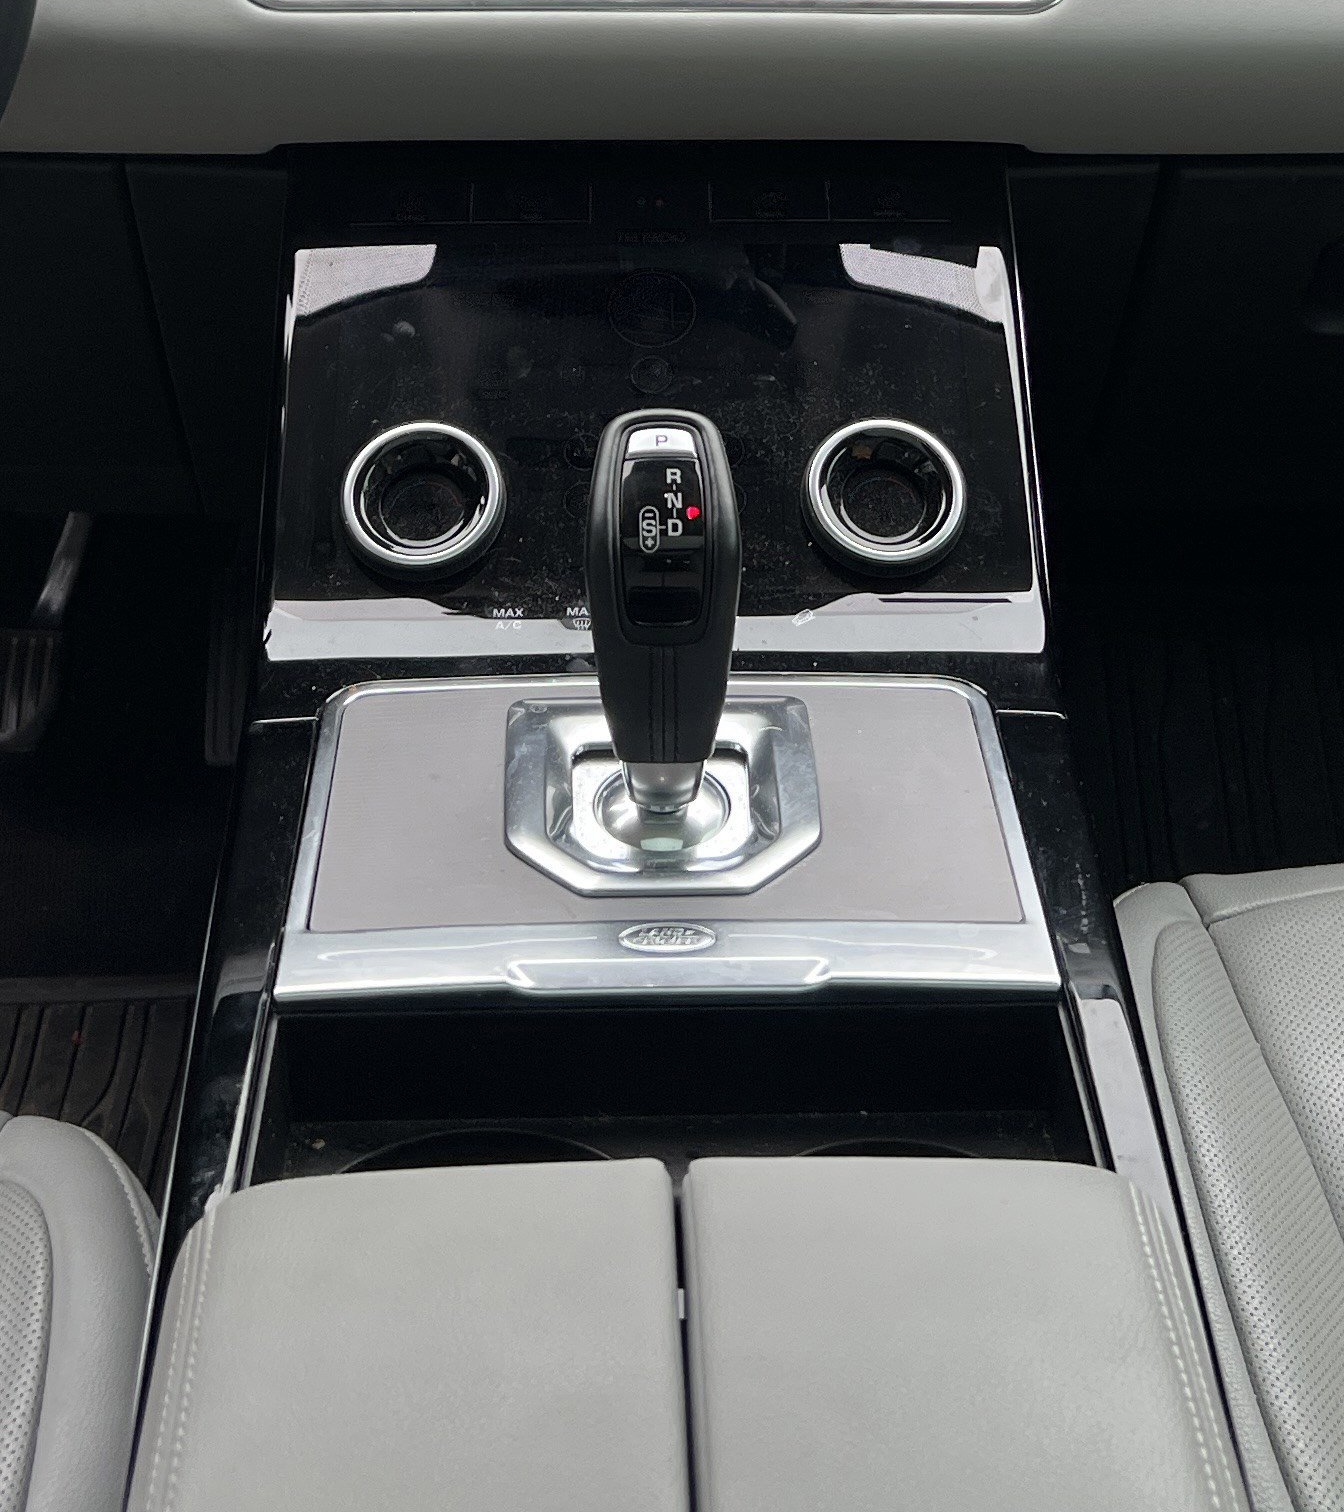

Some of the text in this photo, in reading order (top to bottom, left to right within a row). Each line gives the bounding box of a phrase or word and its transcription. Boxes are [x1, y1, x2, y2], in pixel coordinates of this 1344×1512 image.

[655, 435, 668, 446] P
[666, 468, 682, 484] R
[666, 492, 683, 509] N
[642, 519, 657, 536] S
[667, 519, 683, 537] D
[492, 607, 524, 618] MAX
[566, 606, 591, 617] MA
[494, 620, 523, 630] A/C
